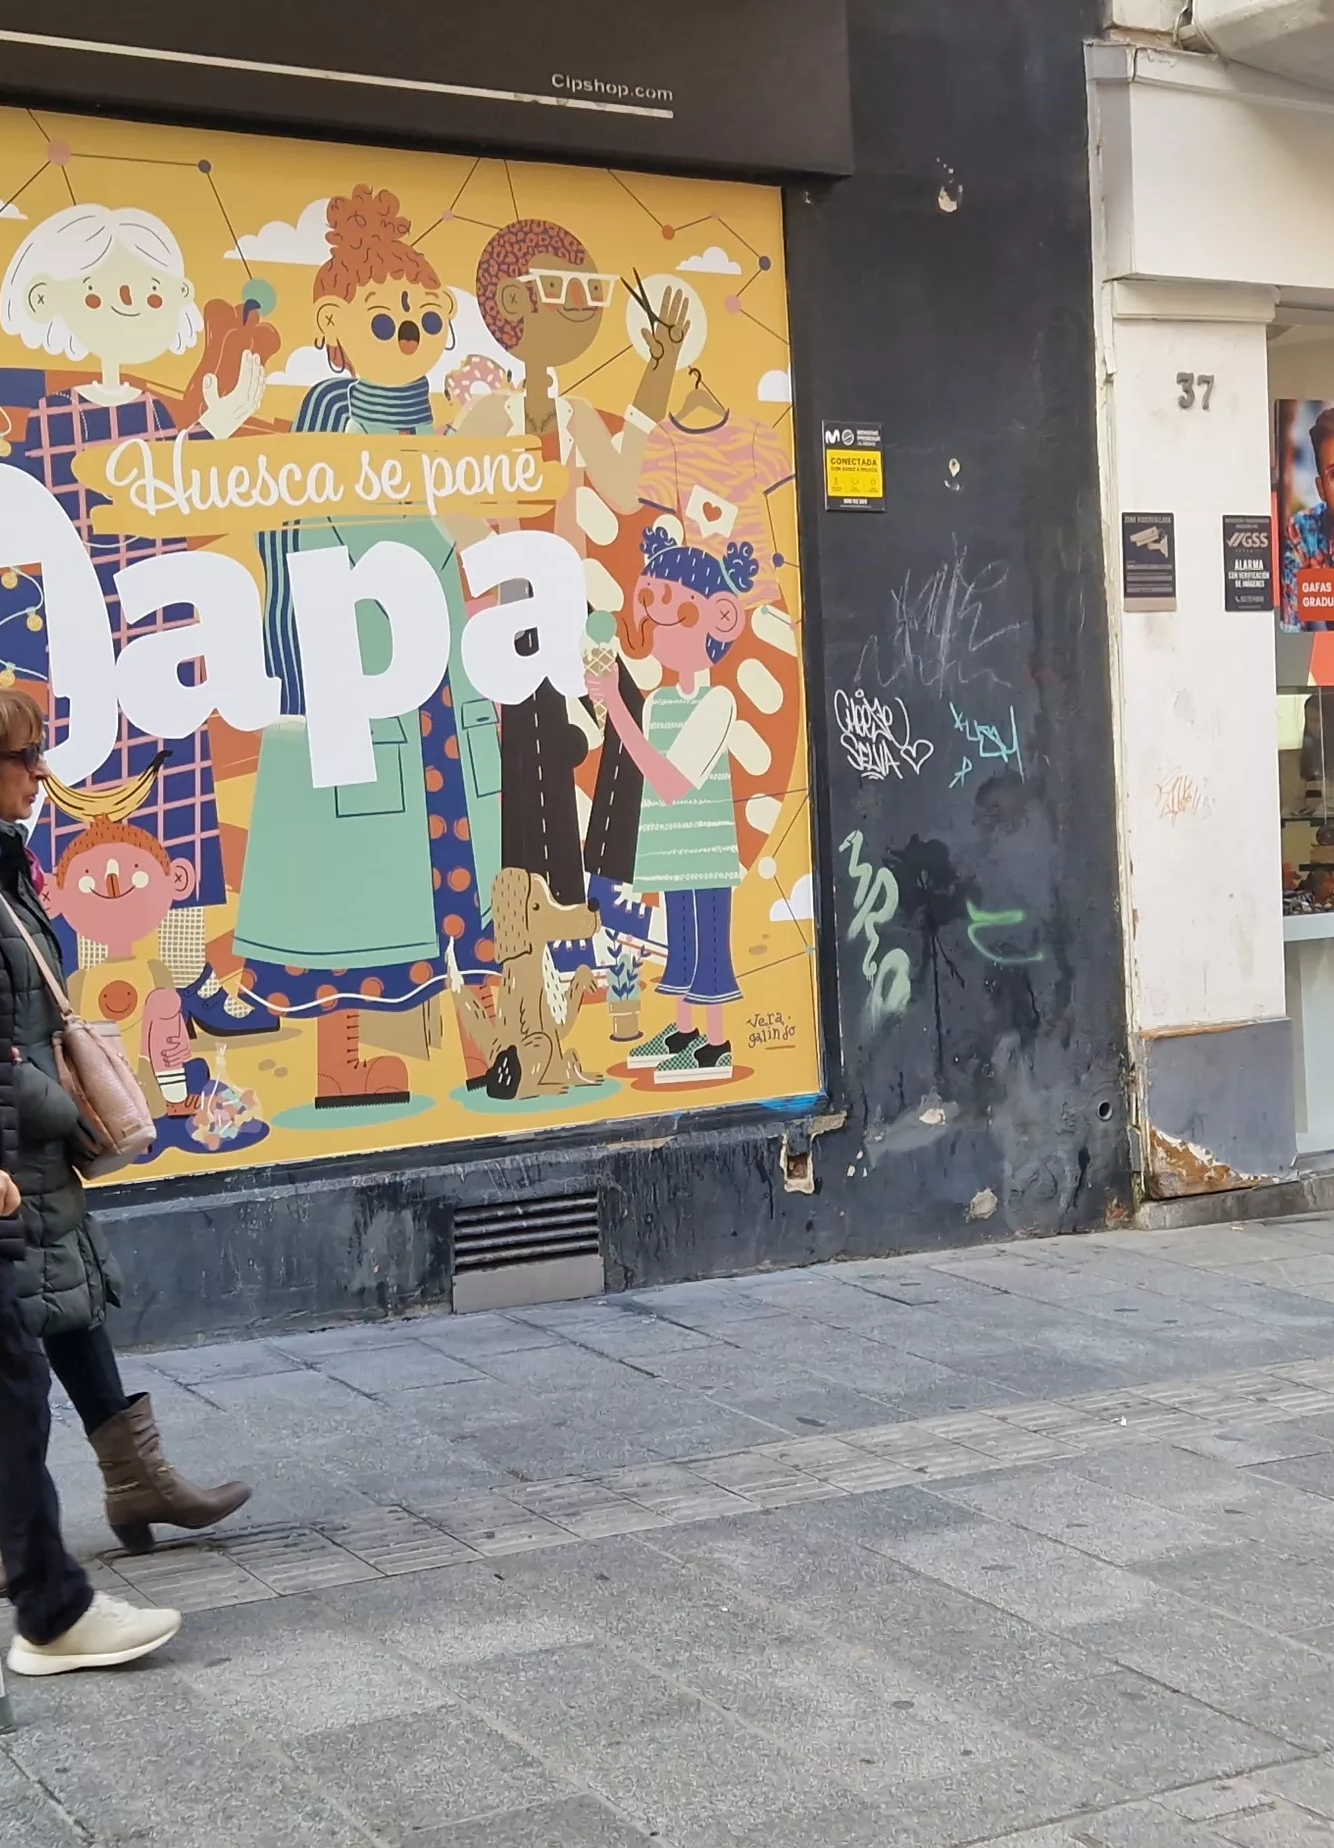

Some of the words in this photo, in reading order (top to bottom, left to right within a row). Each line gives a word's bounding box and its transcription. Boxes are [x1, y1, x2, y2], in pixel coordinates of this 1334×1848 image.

[1176, 371, 1215, 411] 37
[105, 429, 344, 516] Huesca
[354, 451, 411, 501] se
[421, 453, 544, 516] pone
[1242, 532, 1269, 548] GSS
[1234, 559, 1264, 570] ALARMA
[1302, 582, 1332, 593] GAFAS
